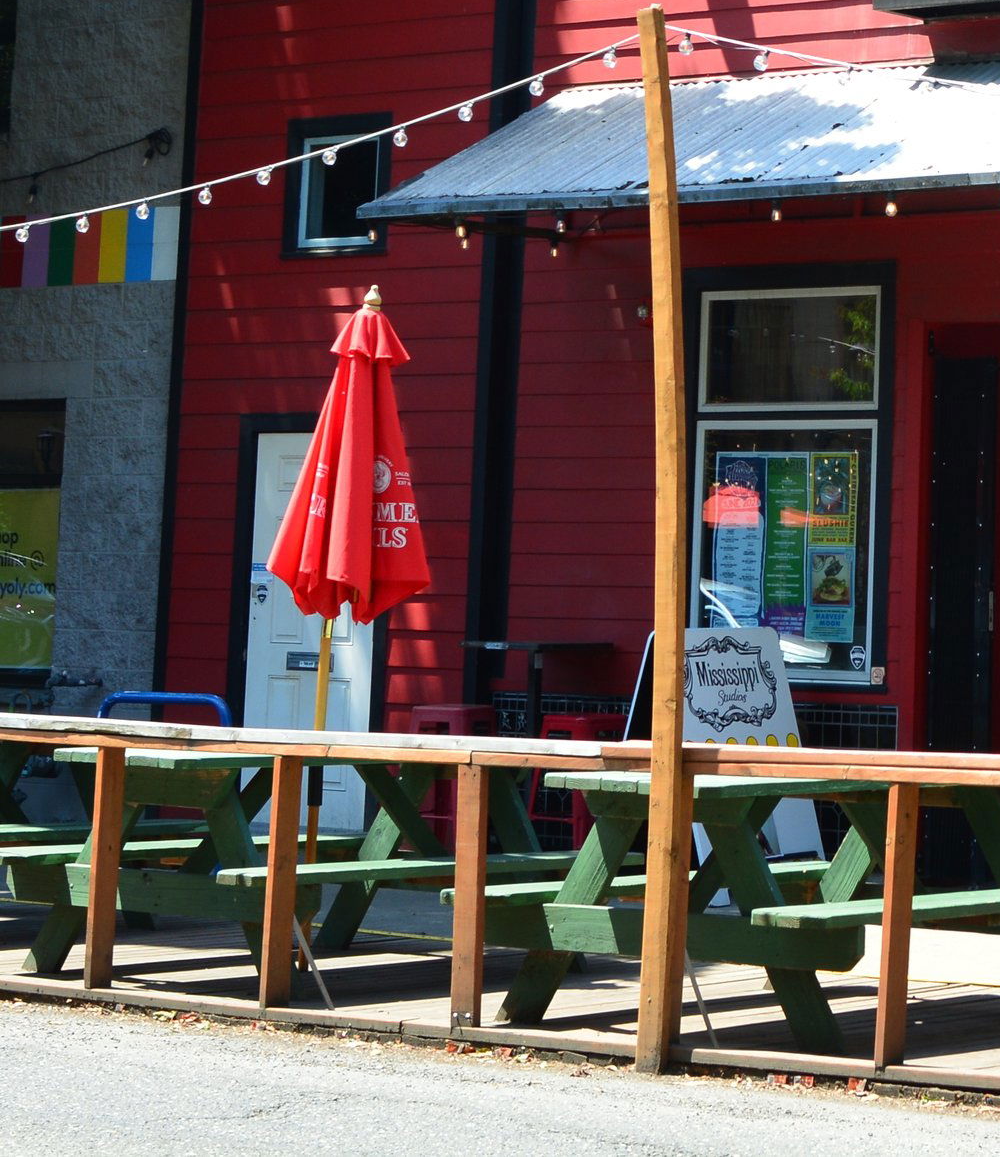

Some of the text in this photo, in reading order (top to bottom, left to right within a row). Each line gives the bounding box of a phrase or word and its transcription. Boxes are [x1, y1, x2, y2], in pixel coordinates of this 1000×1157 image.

[0, 532, 18, 549] op
[696, 661, 760, 692] Mississippi
[717, 688, 748, 706] Studios
